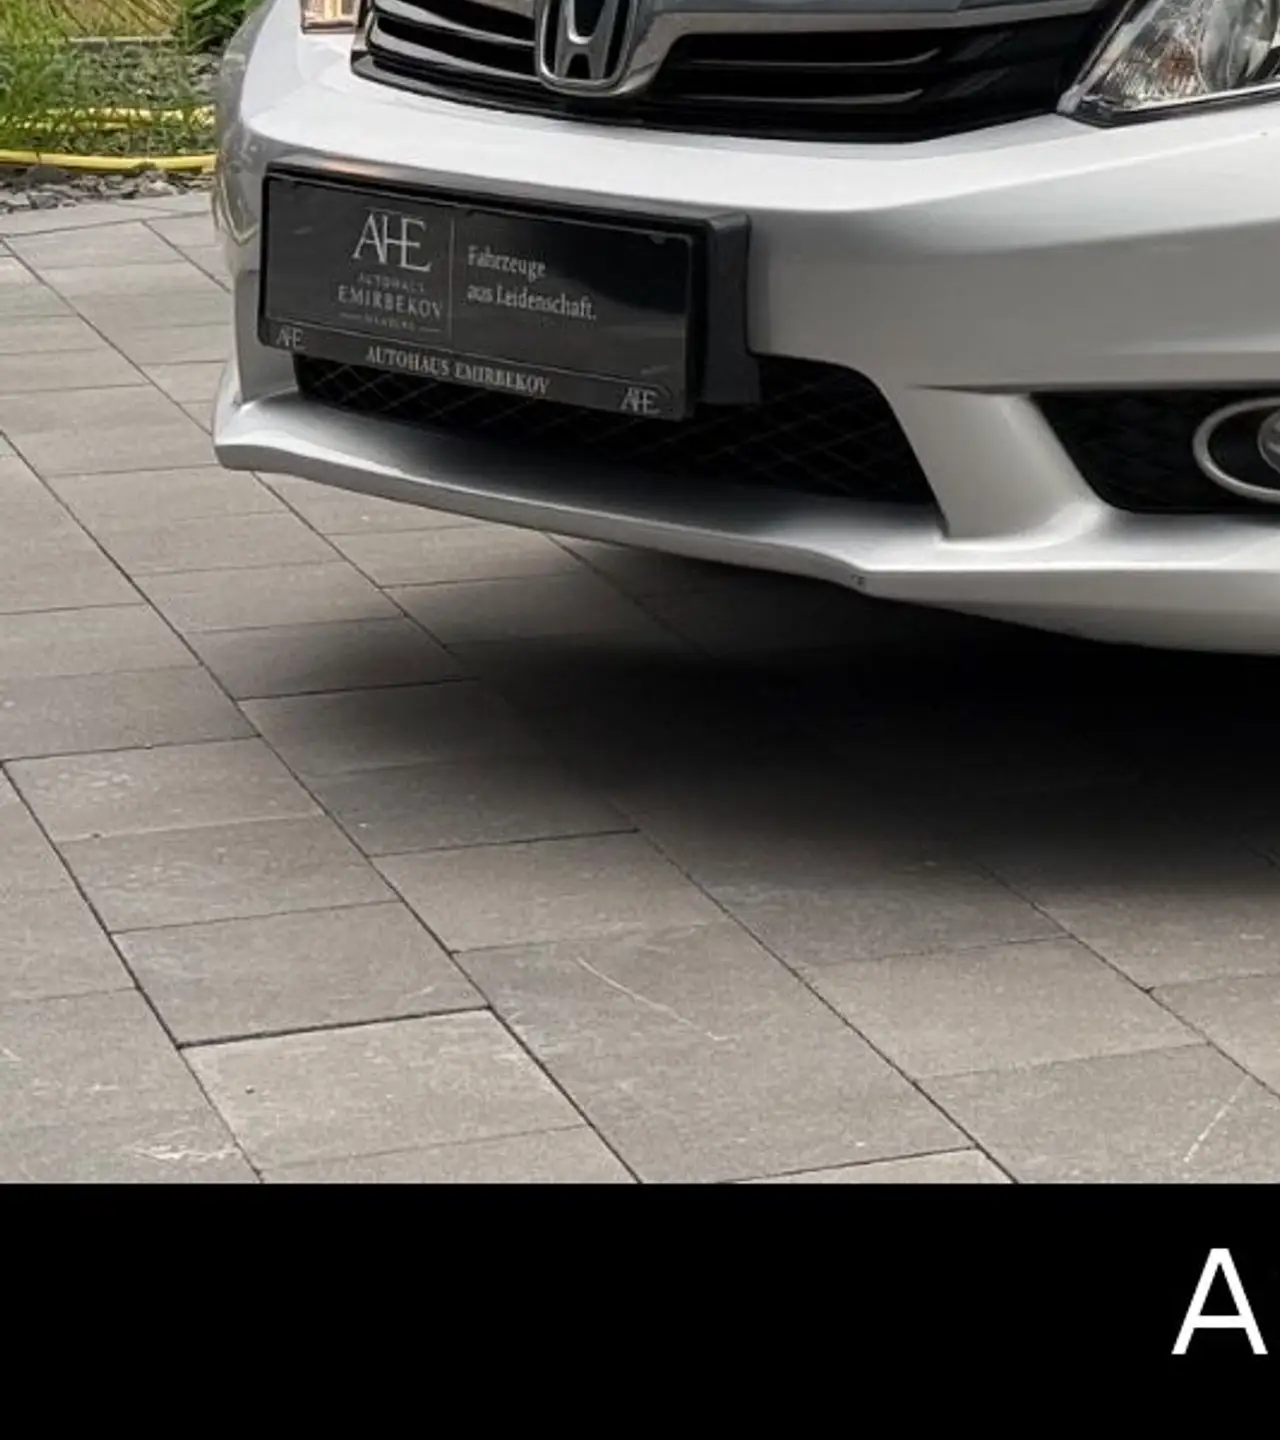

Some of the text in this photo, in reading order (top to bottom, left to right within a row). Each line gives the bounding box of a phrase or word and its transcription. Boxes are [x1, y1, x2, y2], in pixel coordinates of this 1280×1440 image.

[467, 244, 547, 282] Fahrzeuge
[337, 284, 443, 320] EMIRBEKOV
[467, 283, 598, 322] aus Leidenschaft.
[365, 345, 551, 396] AUTOHAUS EMIRBEKOV
